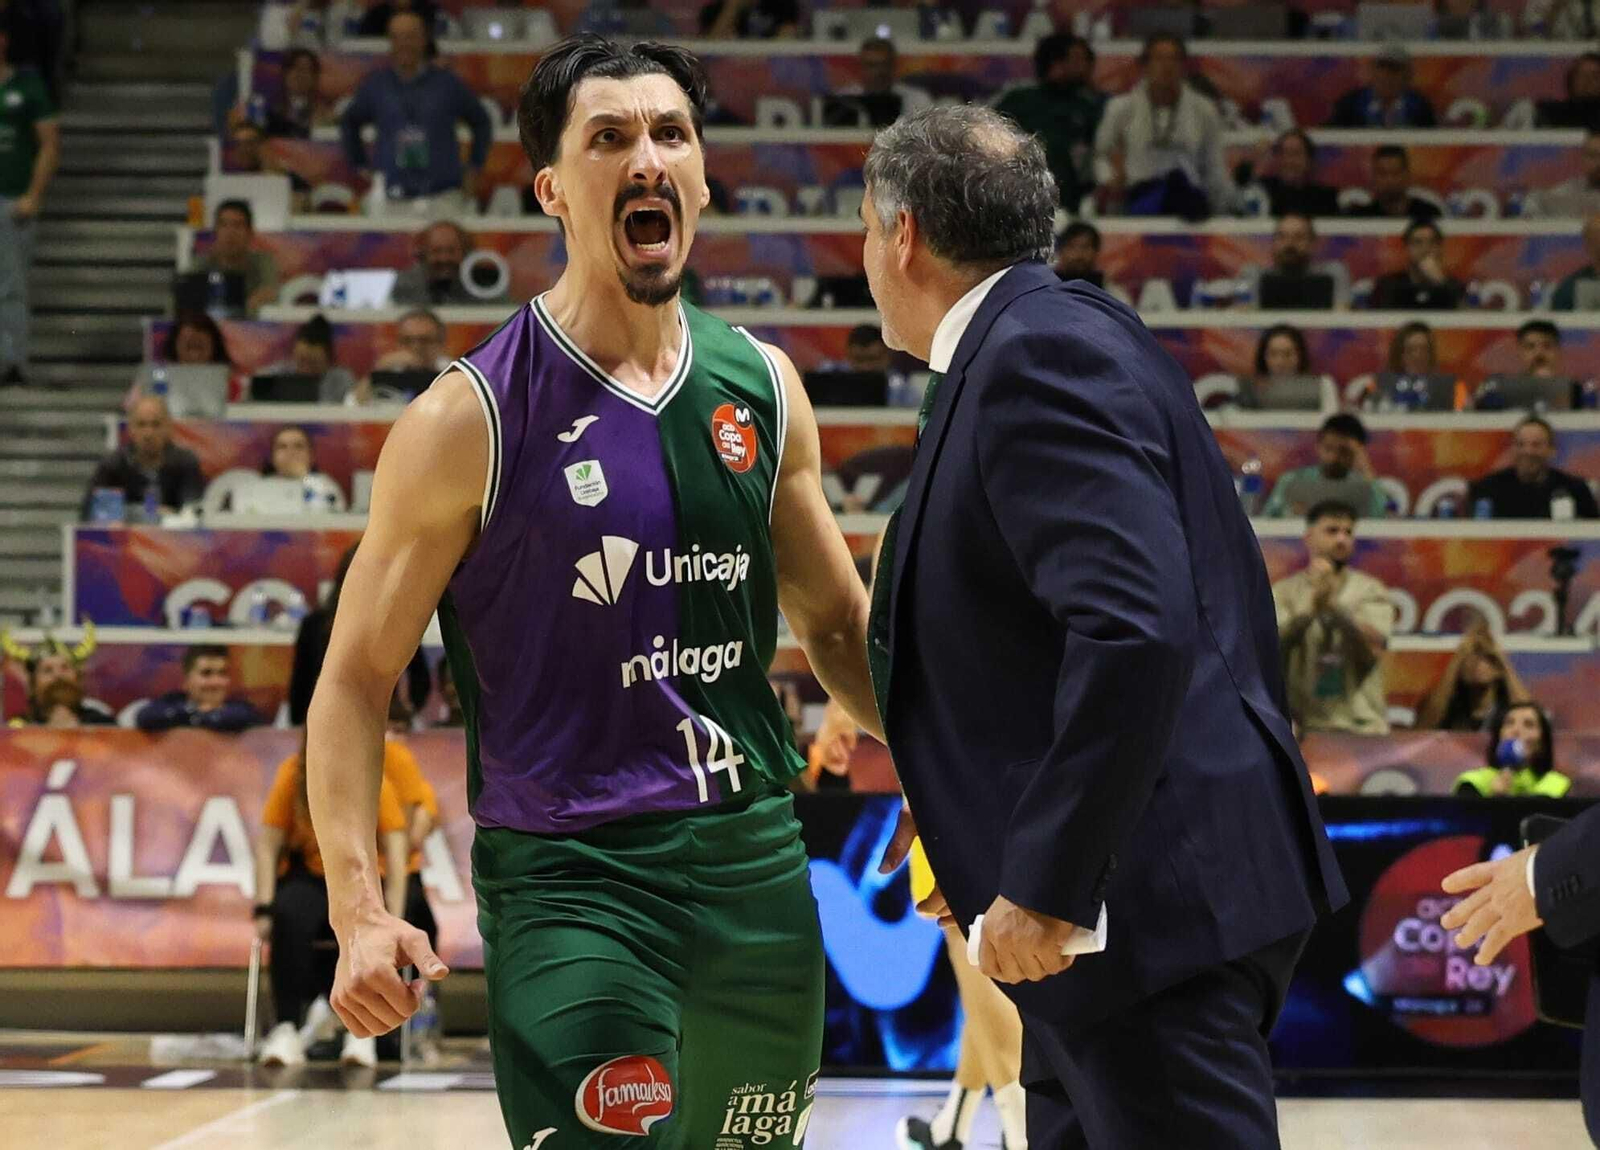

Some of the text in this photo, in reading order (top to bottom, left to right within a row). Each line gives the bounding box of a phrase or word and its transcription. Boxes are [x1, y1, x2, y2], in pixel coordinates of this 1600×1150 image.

[719, 429, 742, 443] Copa
[645, 543, 751, 592] Unicaja
[620, 634, 744, 689] málaga
[676, 714, 745, 804] 14
[594, 1063, 672, 1122] famadesa
[731, 1083, 767, 1094] sabor
